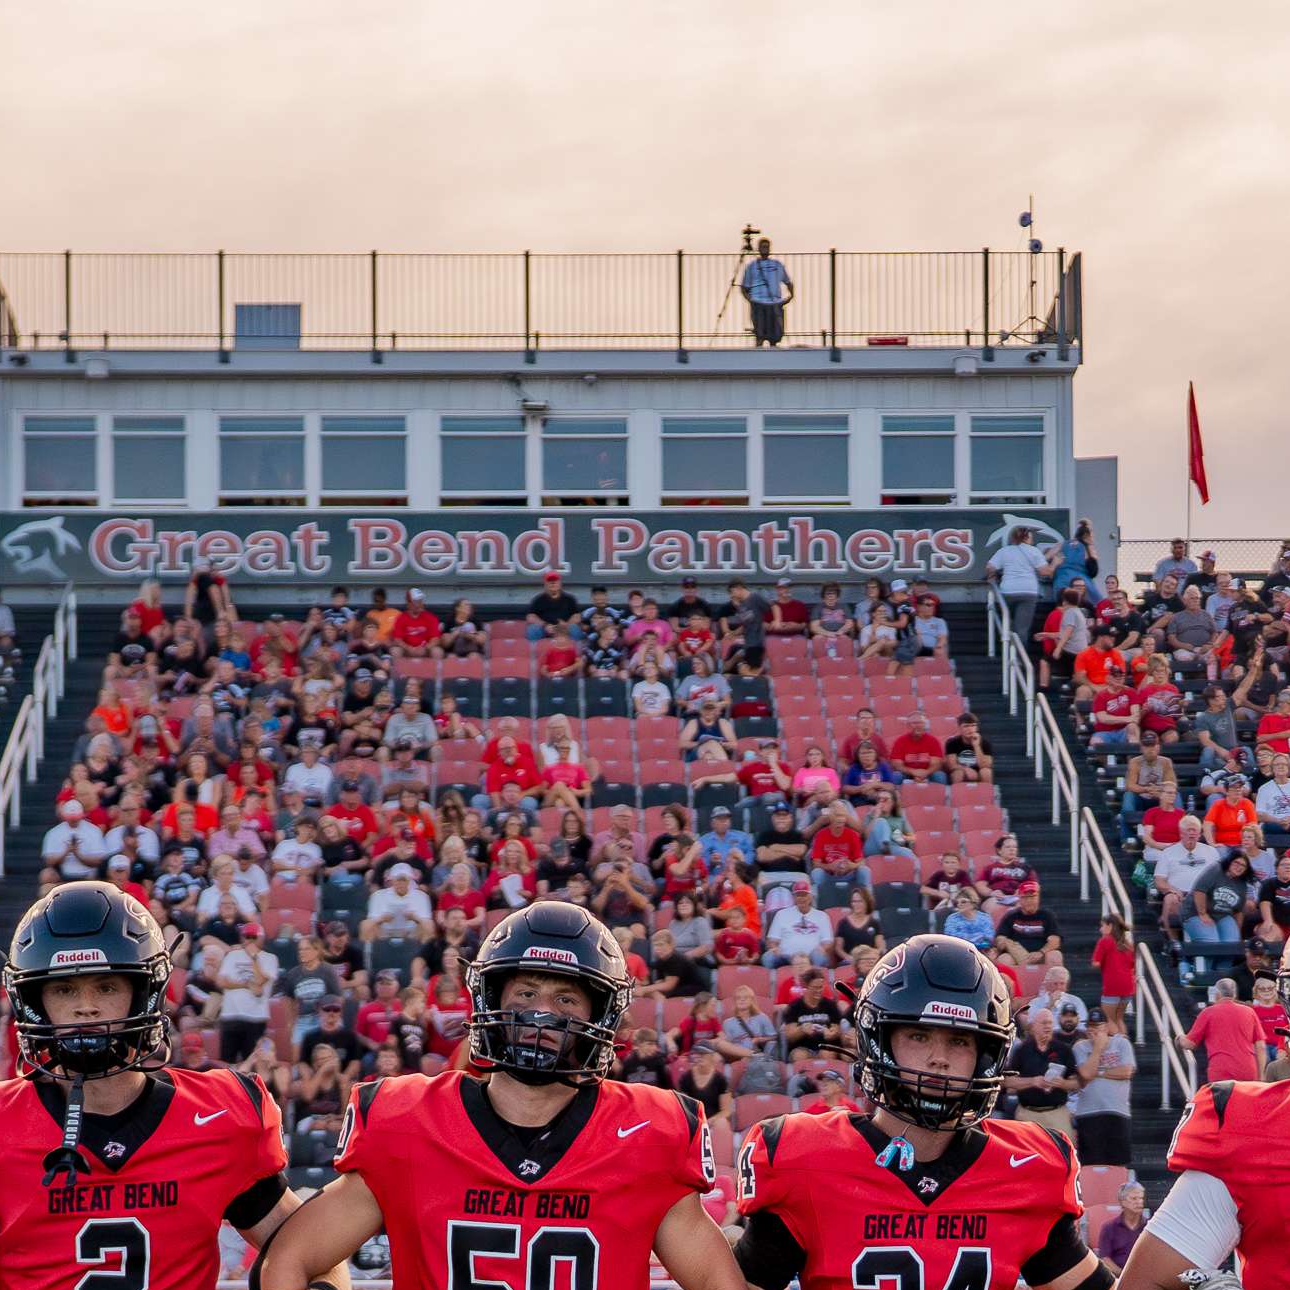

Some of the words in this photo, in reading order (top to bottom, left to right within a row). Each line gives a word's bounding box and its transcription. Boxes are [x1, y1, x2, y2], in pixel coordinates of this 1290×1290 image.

[88, 517, 331, 576] Great
[347, 517, 570, 576] Bend
[591, 517, 976, 575] Panthers
[56, 952, 100, 963] Riddell
[529, 949, 573, 962] Riddell
[931, 1004, 972, 1019] Riddell
[67, 1103, 82, 1148] JORDAN
[736, 1141, 757, 1201] 4
[48, 1183, 115, 1215] GREAT
[123, 1180, 179, 1211] BEND
[463, 1188, 528, 1218] GREAT
[534, 1192, 592, 1220] BEND
[863, 1214, 927, 1240] GREAT
[935, 1214, 988, 1241] BEND
